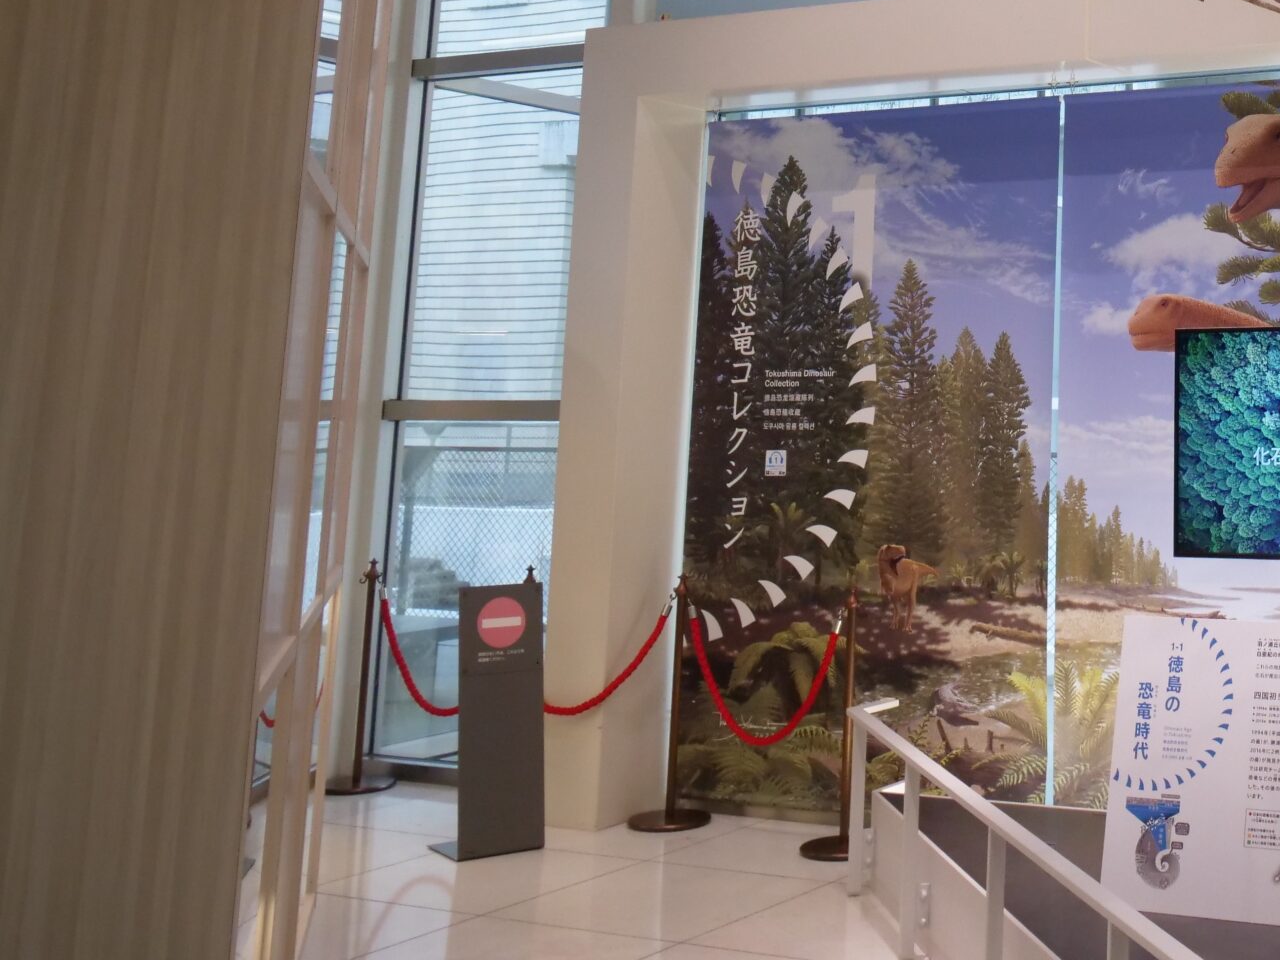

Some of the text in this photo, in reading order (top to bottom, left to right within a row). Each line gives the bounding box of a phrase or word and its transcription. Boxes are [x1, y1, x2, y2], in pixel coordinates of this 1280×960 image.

[723, 209, 761, 549] 徳島恐竜コレクション
[765, 368, 835, 378] Tokushima Dinosaur
[765, 379, 800, 388] Collection
[1171, 643, 1184, 652] 1-1
[1165, 655, 1184, 713] 徳島の
[1133, 682, 1154, 761] 恐竜時代
